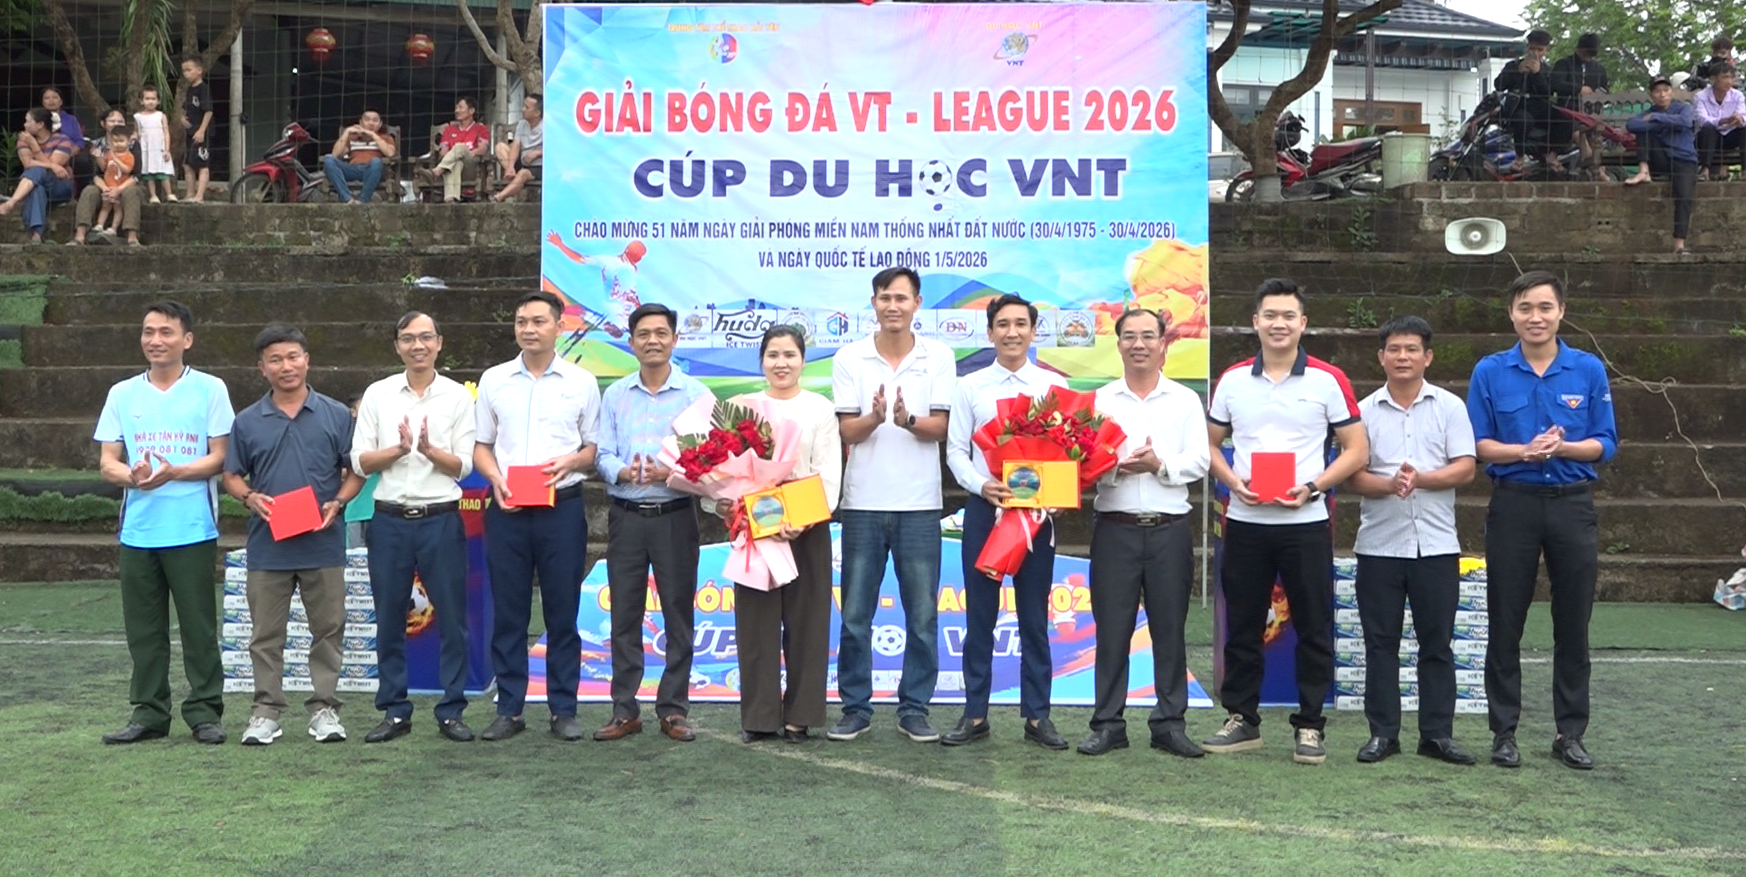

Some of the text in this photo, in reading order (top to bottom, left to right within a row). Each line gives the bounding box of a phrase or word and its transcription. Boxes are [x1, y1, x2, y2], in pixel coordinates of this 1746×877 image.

[576, 80, 1176, 133] GIẢI BÓNG ĐÁ VT - LEAGUE 2026
[634, 150, 747, 198] CÚP
[769, 159, 850, 198] DU
[1007, 158, 1127, 197] VNT
[574, 218, 607, 238] CHÀO
[611, 218, 648, 238] MỪNG
[652, 222, 665, 238] 51
[670, 218, 699, 238] NĂM
[703, 218, 736, 239] NGÀY
[740, 216, 764, 239] GIẢI
[769, 218, 810, 239] PHÓNG
[851, 222, 879, 238] NAM
[884, 216, 924, 238] THỐNG
[929, 215, 960, 238] NHẤT
[964, 215, 988, 238] ĐẤT
[992, 218, 1026, 238] NƯỚC
[1031, 221, 1096, 239] (30/4/1975
[1109, 221, 1175, 239] 30/4/2026)
[759, 248, 774, 268] VÀ
[778, 248, 811, 268] NGÀY
[815, 245, 848, 269] QUỐC
[852, 245, 867, 267] TẾ
[870, 251, 892, 268] LAO
[935, 251, 987, 267] 1/5/2026
